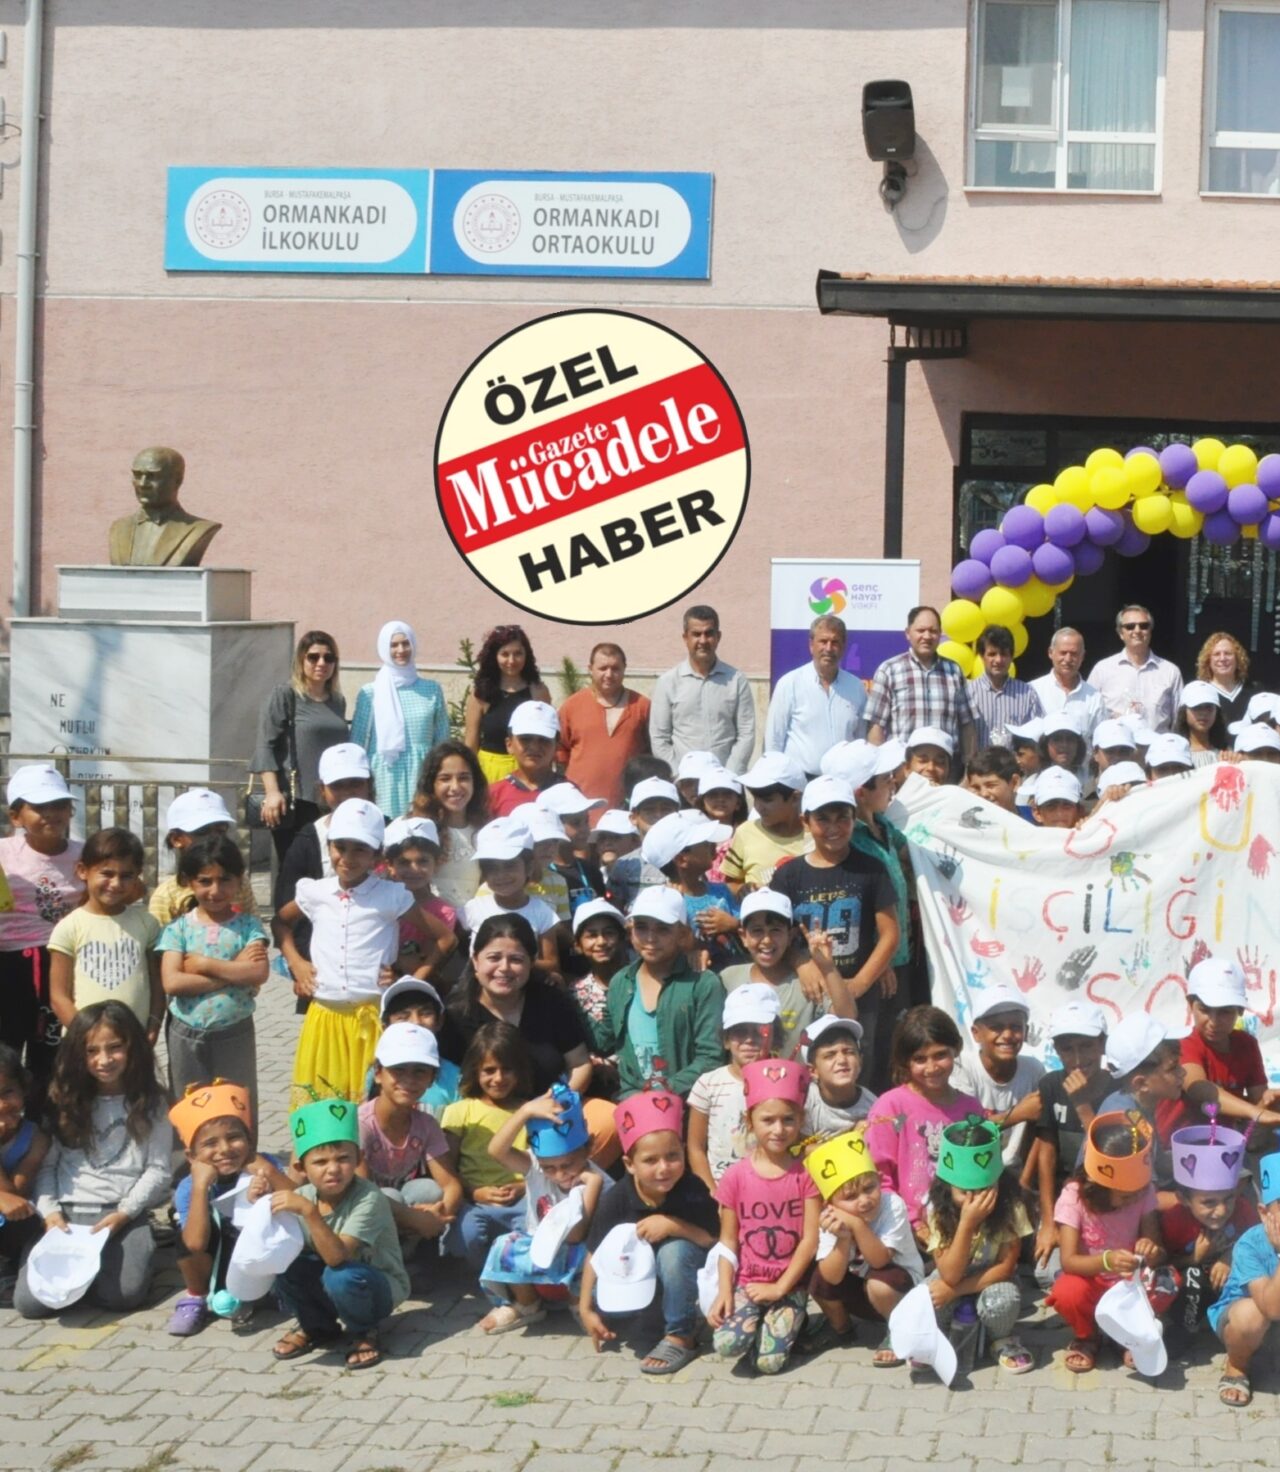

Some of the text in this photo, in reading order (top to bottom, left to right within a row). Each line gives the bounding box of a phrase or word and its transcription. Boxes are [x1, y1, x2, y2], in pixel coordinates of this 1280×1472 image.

[263, 204, 387, 225] ORMANKADI
[533, 207, 660, 228] ORMANKADI
[262, 226, 360, 251] İLKOKULU
[532, 234, 655, 255] ORTAOKULU
[50, 693, 66, 708] NE
[60, 719, 96, 734] MUTLU
[739, 1199, 804, 1221] LOVE
